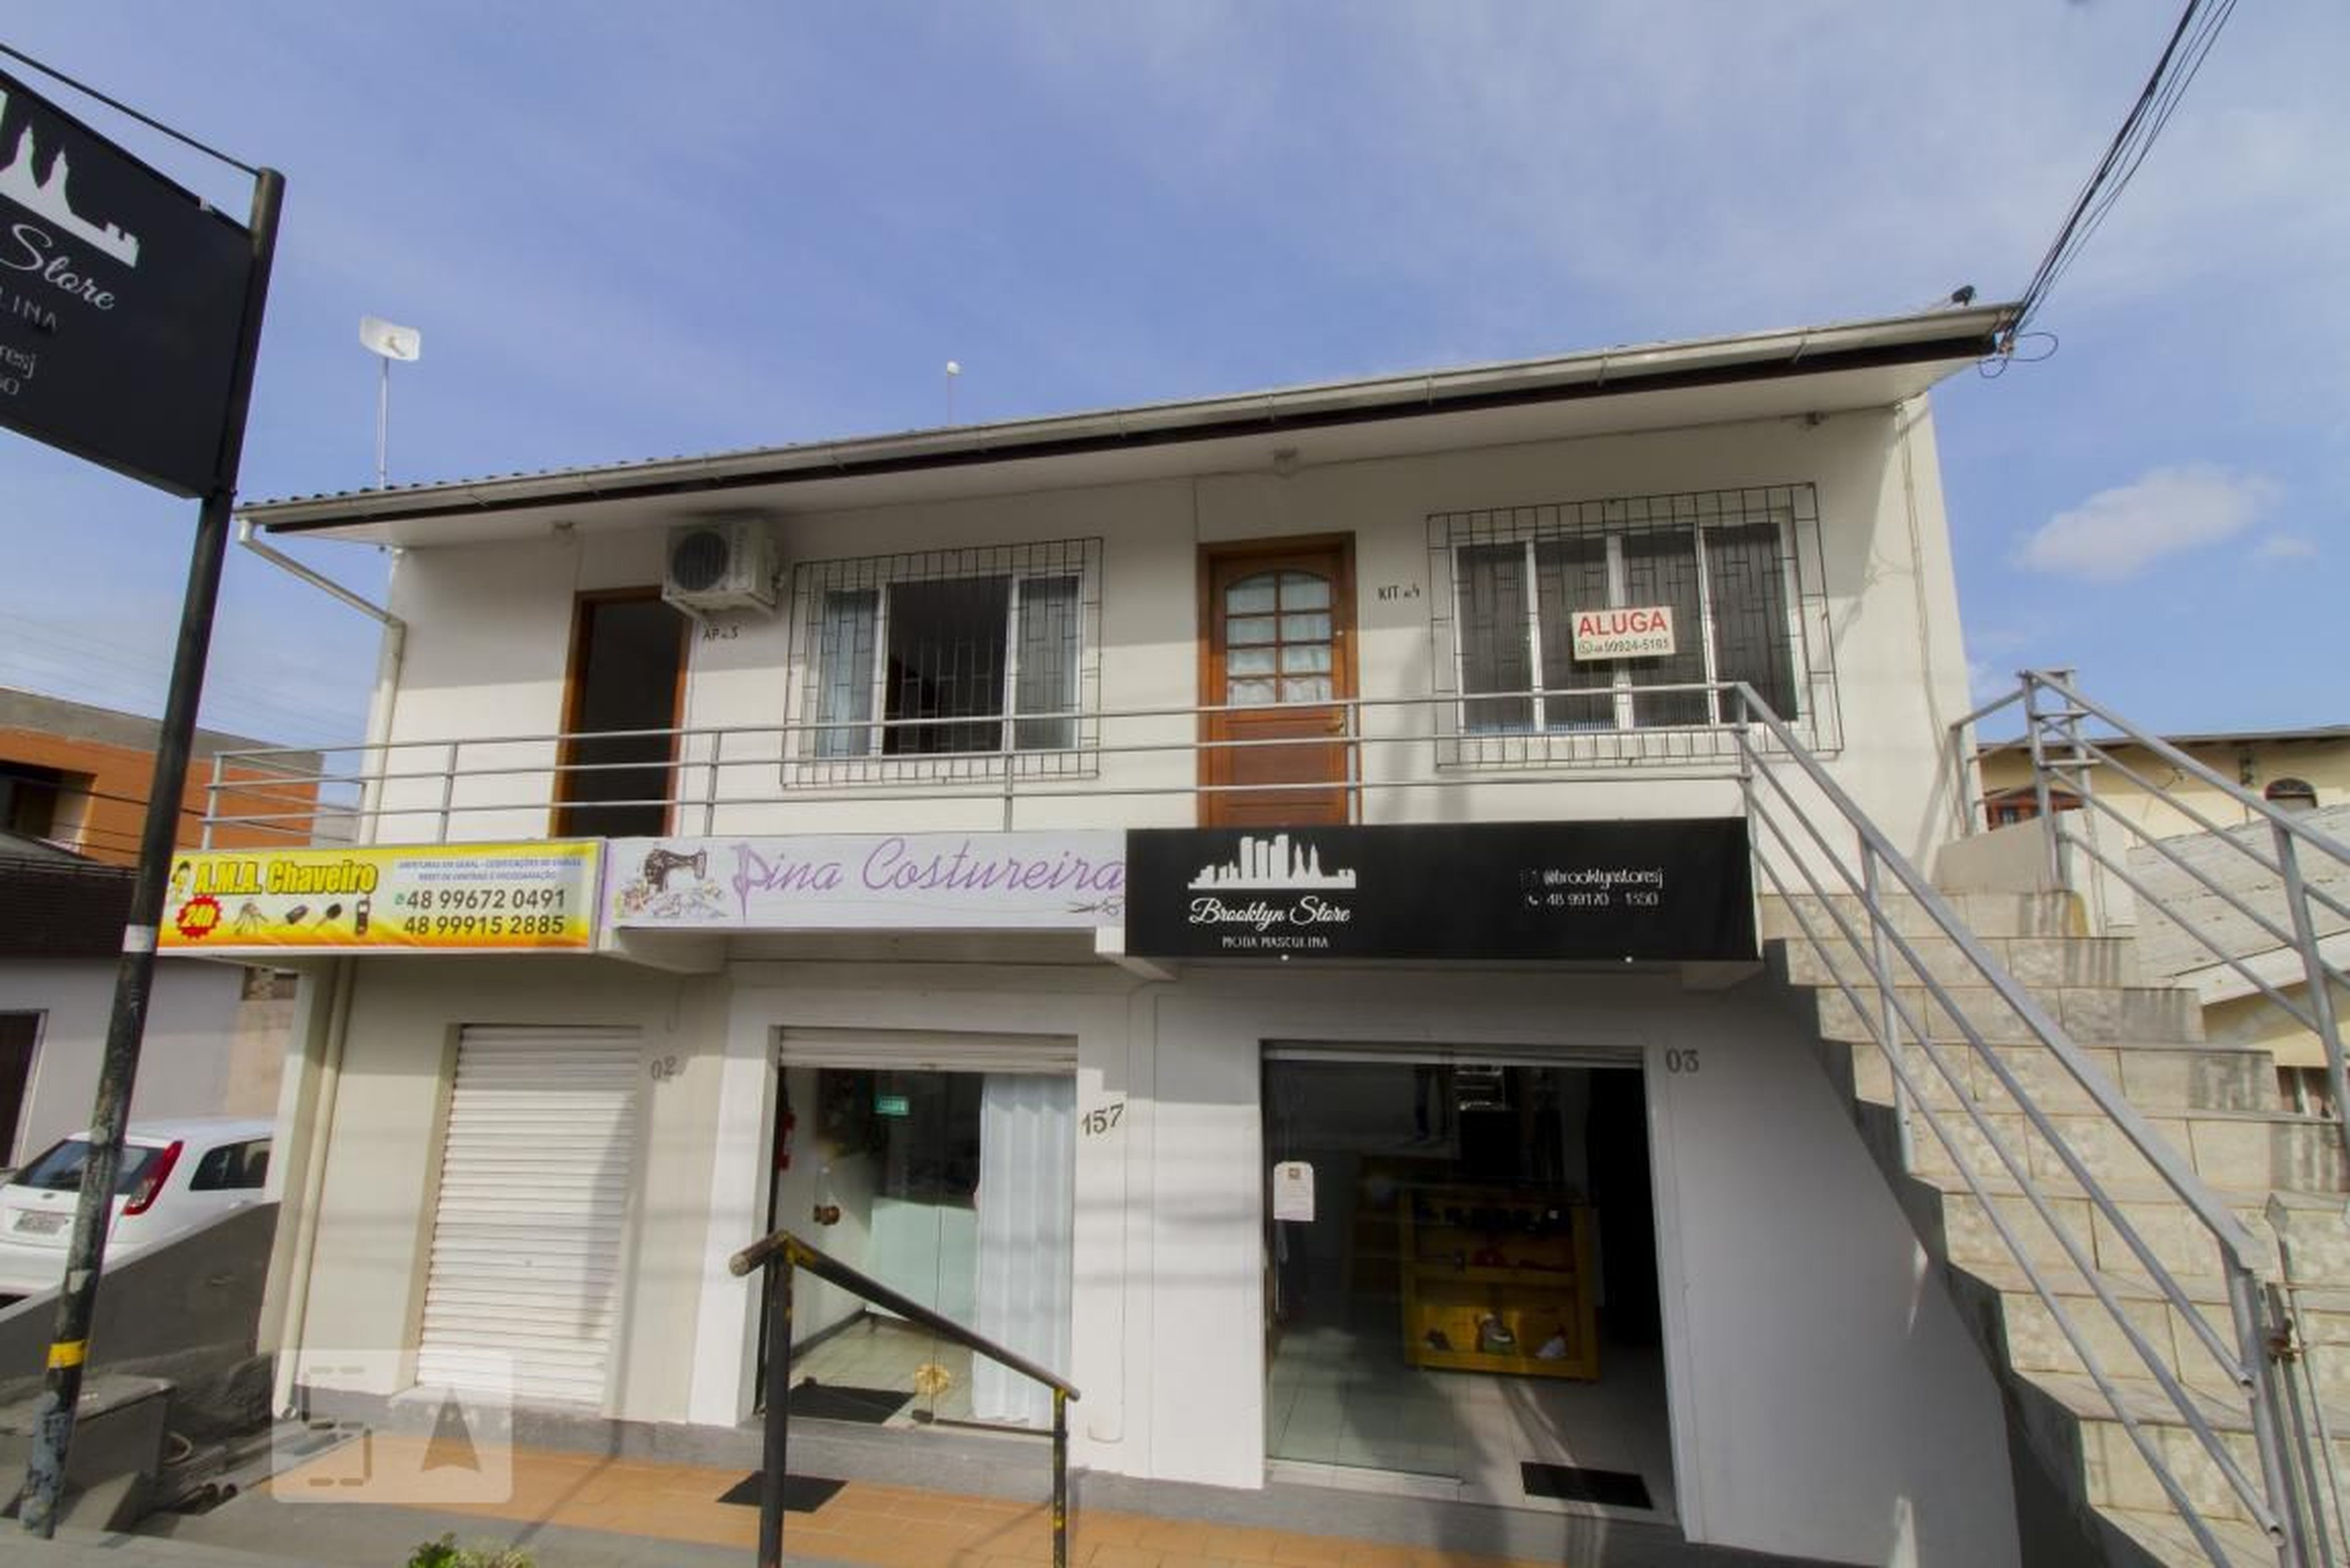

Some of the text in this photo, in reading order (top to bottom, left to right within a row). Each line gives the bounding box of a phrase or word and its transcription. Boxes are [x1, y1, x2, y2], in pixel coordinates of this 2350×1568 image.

[0, 223, 116, 310] Store
[1578, 610, 1668, 637] ALUGA
[266, 859, 379, 894] Chaveiro
[862, 836, 1125, 891] Costureira
[406, 889, 565, 909] 48 99672 0491
[1189, 895, 1350, 931] Brooklyn Store
[403, 916, 565, 935] 48 99915 2885
[1222, 936, 1329, 948] MODA MASCULINA
[651, 1055, 677, 1081] 02
[1081, 1102, 1124, 1136] 157
